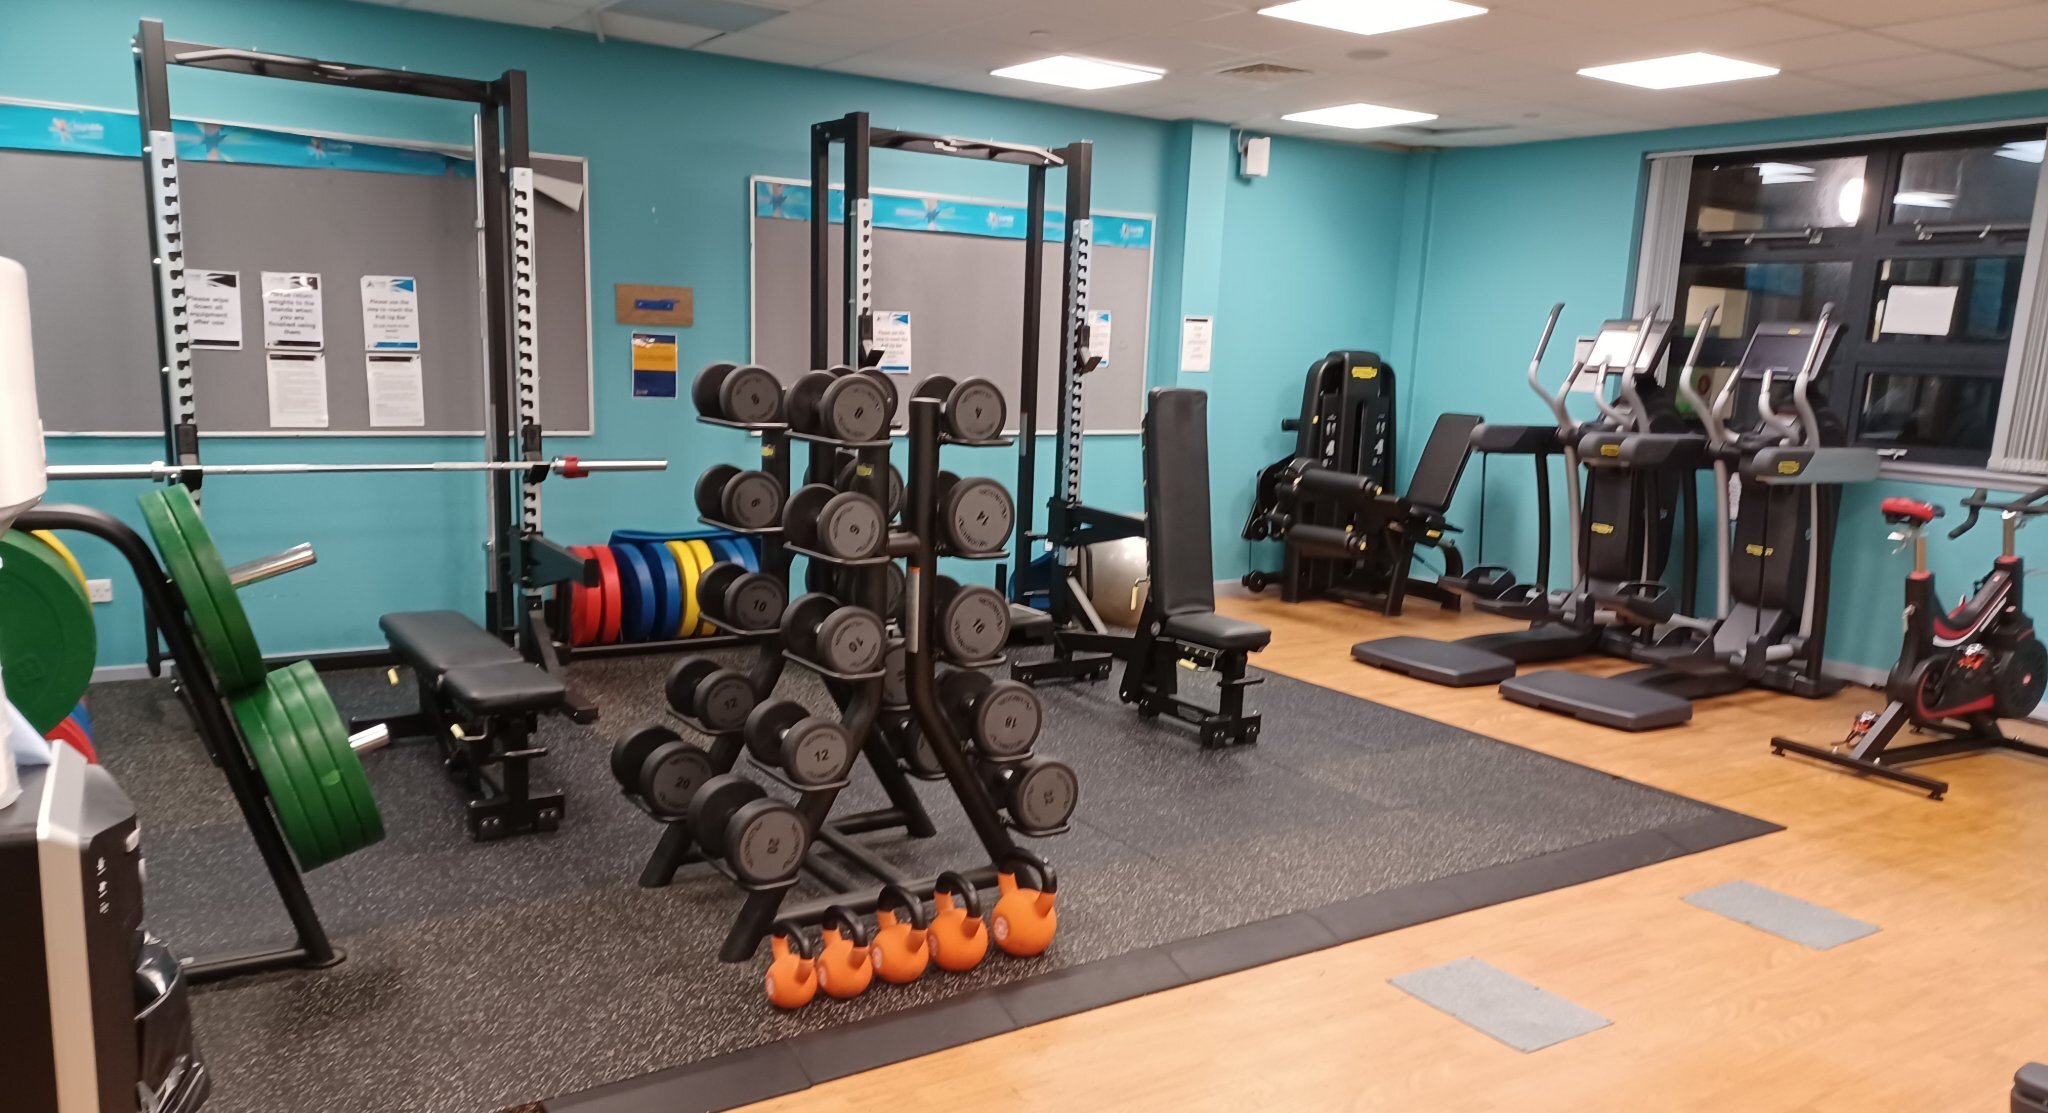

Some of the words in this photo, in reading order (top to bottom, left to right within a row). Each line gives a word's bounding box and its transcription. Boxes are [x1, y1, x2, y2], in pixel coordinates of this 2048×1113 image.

[753, 600, 767, 613] 10
[724, 697, 738, 710] 12
[814, 748, 830, 763] 12
[675, 776, 691, 790] 20
